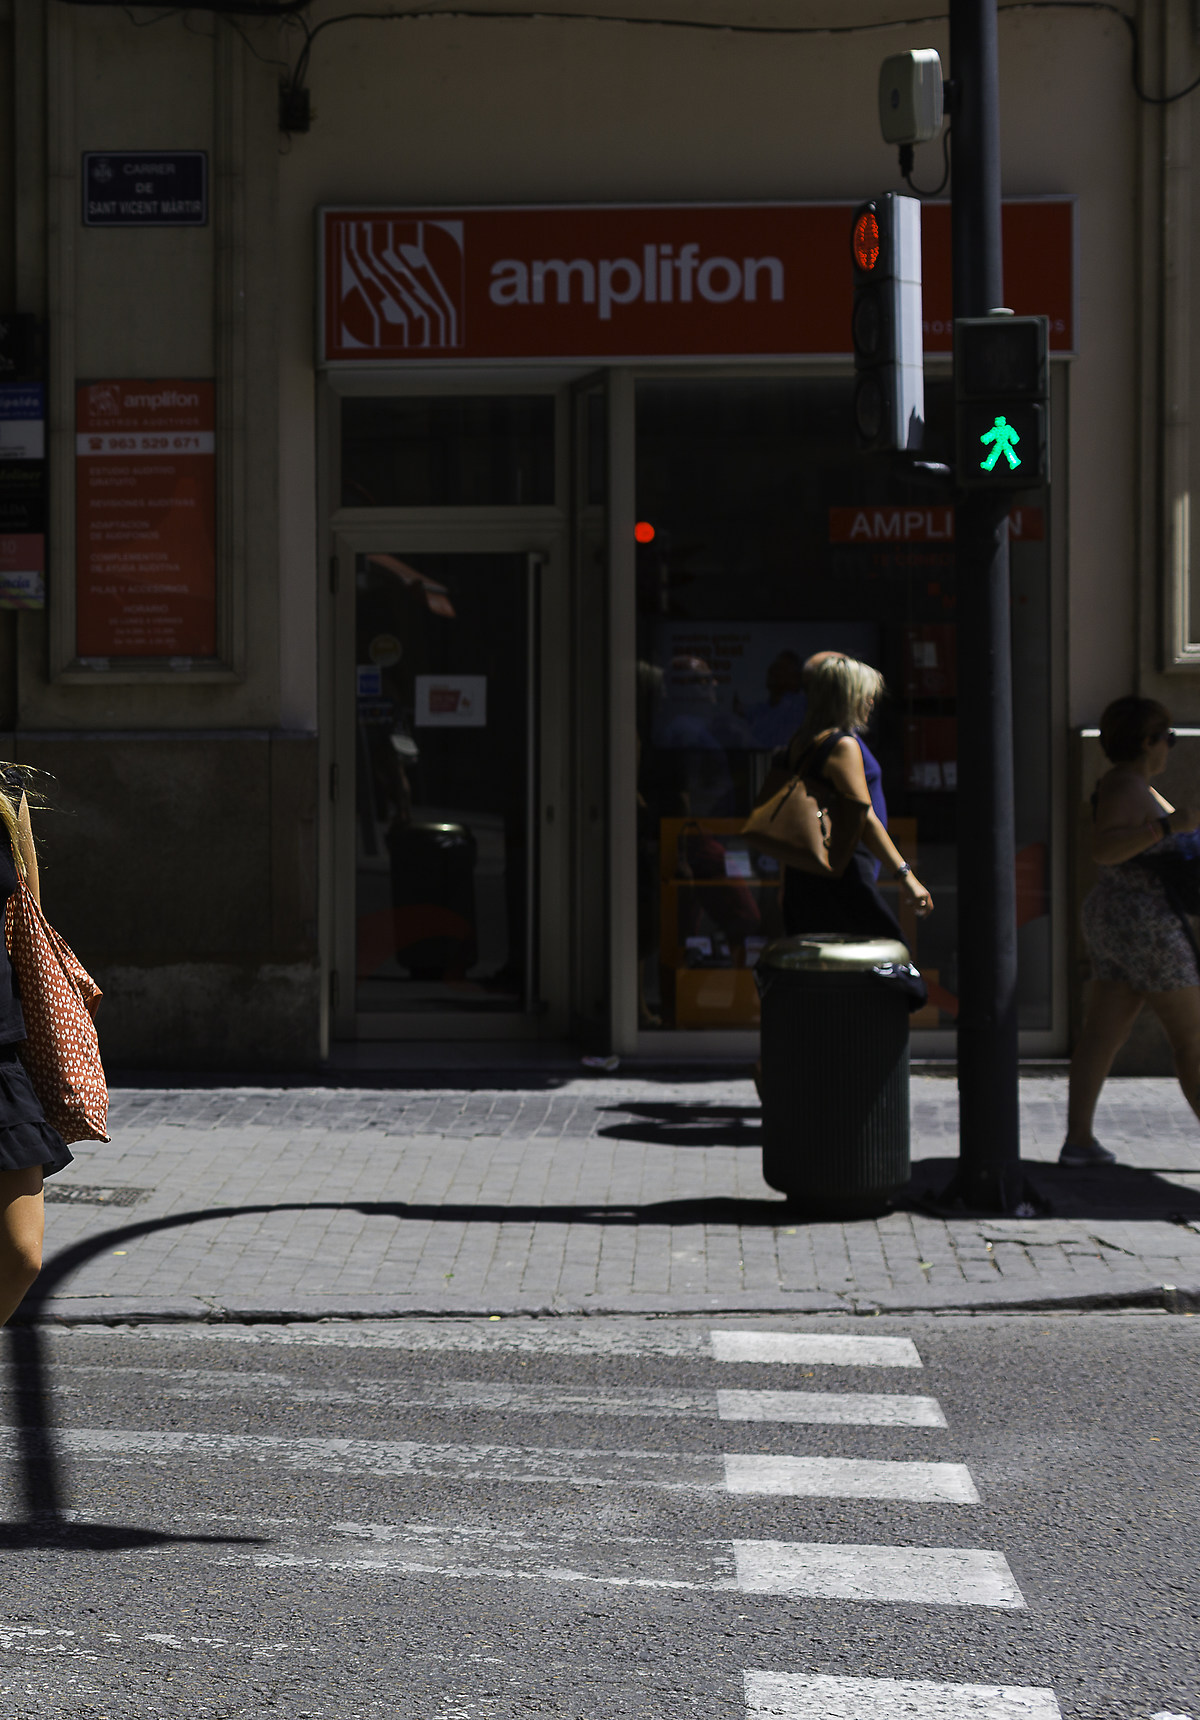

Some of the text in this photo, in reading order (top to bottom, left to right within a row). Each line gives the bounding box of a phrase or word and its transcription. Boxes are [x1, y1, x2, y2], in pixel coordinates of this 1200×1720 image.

[123, 163, 176, 175] CARRER
[135, 182, 154, 194] DE
[89, 201, 117, 215] SANT
[120, 201, 158, 214] VICENT
[489, 242, 785, 321] amplifon
[123, 390, 199, 411] amplifon
[109, 436, 200, 449] 963 529 671
[850, 510, 1023, 539] AMPLIN
